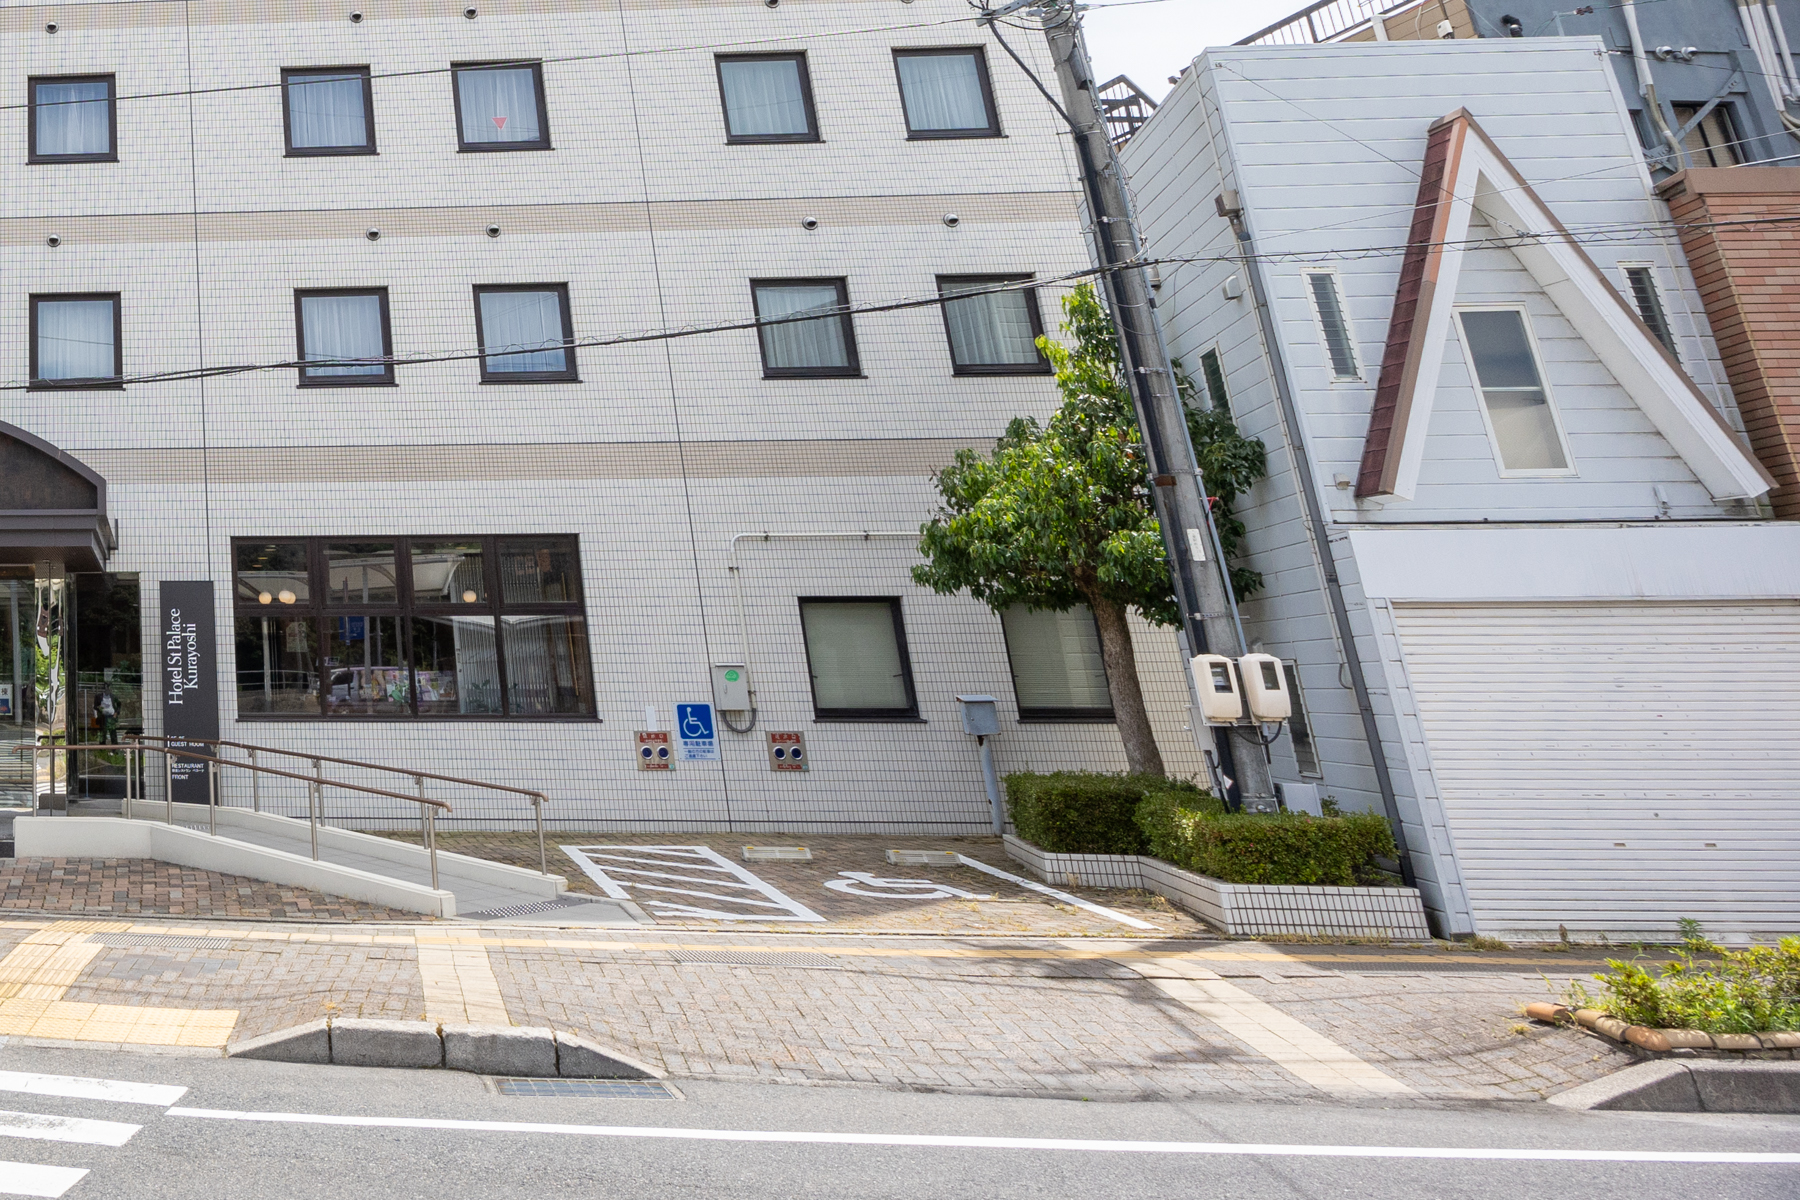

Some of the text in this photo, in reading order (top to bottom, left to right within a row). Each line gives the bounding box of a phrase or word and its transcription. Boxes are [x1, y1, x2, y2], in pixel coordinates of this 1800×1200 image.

[166, 608, 184, 705] Hotel St Palace
[181, 623, 201, 689] Kurayoshi
